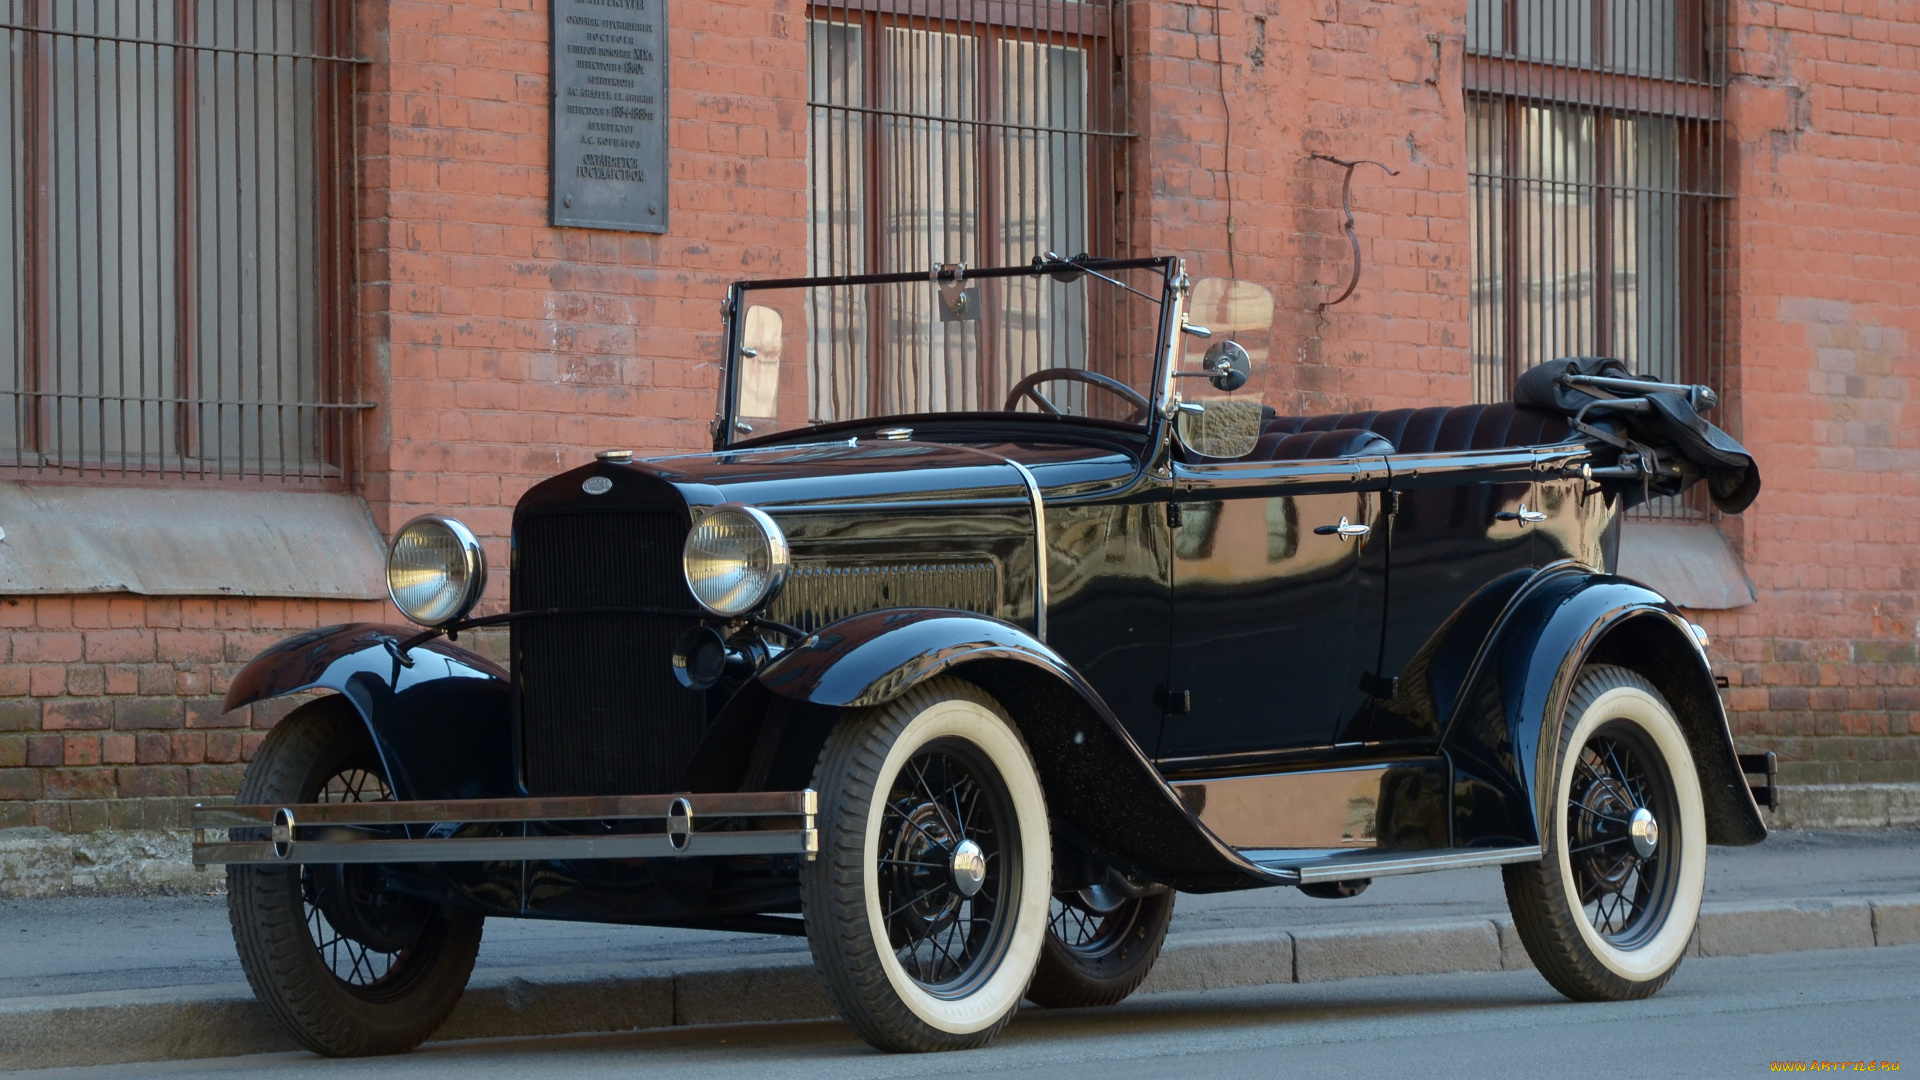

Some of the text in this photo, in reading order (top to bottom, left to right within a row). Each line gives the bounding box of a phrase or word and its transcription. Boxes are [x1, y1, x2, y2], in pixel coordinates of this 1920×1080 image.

[575, 0, 644, 10] ЕКТУРЫ
[566, 15, 600, 28] ОСОБНЯК
[586, 32, 634, 45] ПОСТРОЕН
[572, 45, 597, 55] ПЕРВОЙ
[598, 48, 632, 59] ПОЛОВИНЕ
[577, 59, 617, 72] ПЕРЕСТРОЕН
[587, 75, 634, 88] АРХИТЕКТОРЫ
[567, 104, 605, 116] ПЕРЕСТРОЕН
[587, 121, 634, 134] АРХИТЕКТОР
[582, 153, 638, 169] ОХРАНЯЕТСЯ
[576, 165, 644, 182] ГОСУДАРСТВОМ
